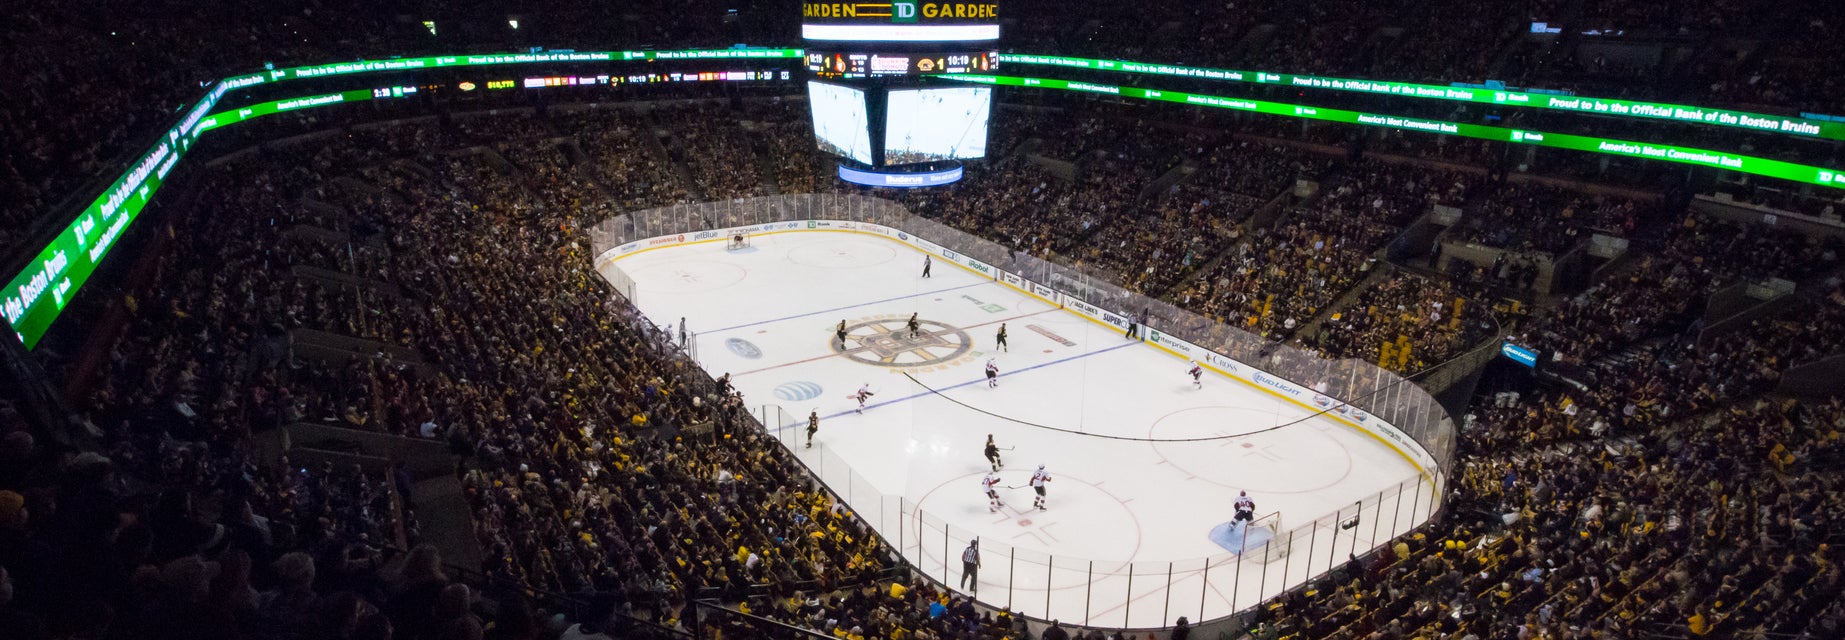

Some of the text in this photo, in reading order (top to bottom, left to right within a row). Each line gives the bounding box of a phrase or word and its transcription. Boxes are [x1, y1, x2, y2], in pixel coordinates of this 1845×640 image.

[895, 3, 915, 17] TD
[923, 4, 992, 18] GARDEN
[937, 58, 944, 70] 1
[947, 55, 969, 66] 10:19
[972, 57, 978, 69] 1
[1293, 77, 1312, 85] Proud
[1332, 80, 1343, 88] the
[1345, 82, 1370, 90] Official
[1372, 84, 1390, 92] Bank
[1402, 86, 1415, 94] the
[1417, 87, 1444, 96] Boston
[1446, 90, 1472, 98] Bruins
[1358, 115, 1458, 132] America's Most Convenient Bank
[1549, 98, 1819, 134] Proud to be the Official Bank of the Boston Bruins
[1599, 142, 1742, 167] America's Most Convenient Bank
[694, 231, 718, 241] jetBlue
[968, 260, 989, 273] iRobot
[6, 297, 24, 324] the
[20, 270, 49, 309] Boston
[1254, 373, 1302, 396] BUD LIGHT
